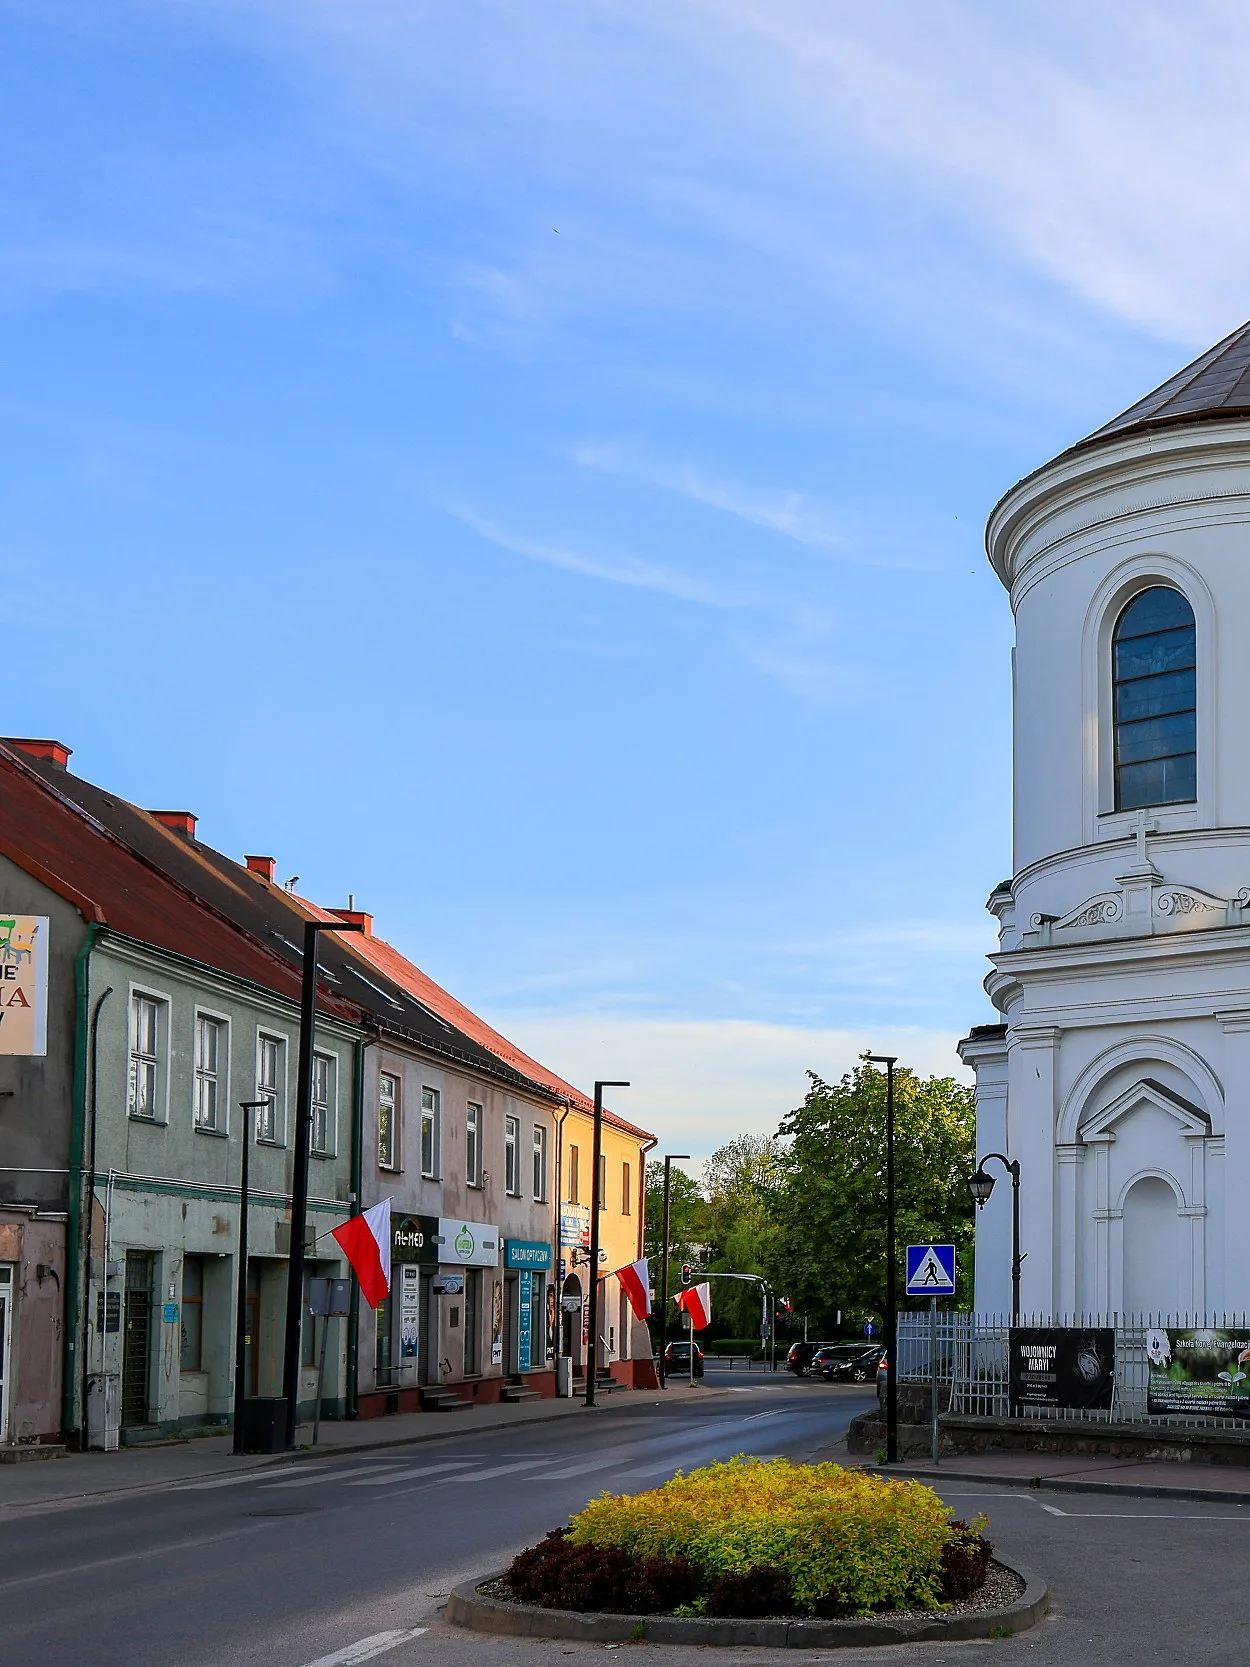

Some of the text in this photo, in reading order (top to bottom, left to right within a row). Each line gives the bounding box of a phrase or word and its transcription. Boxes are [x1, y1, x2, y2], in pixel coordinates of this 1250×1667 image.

[511, 1247, 527, 1261] SALON
[1020, 1345, 1057, 1358] WOJOWNICY
[1028, 1358, 1049, 1371] MARYI
